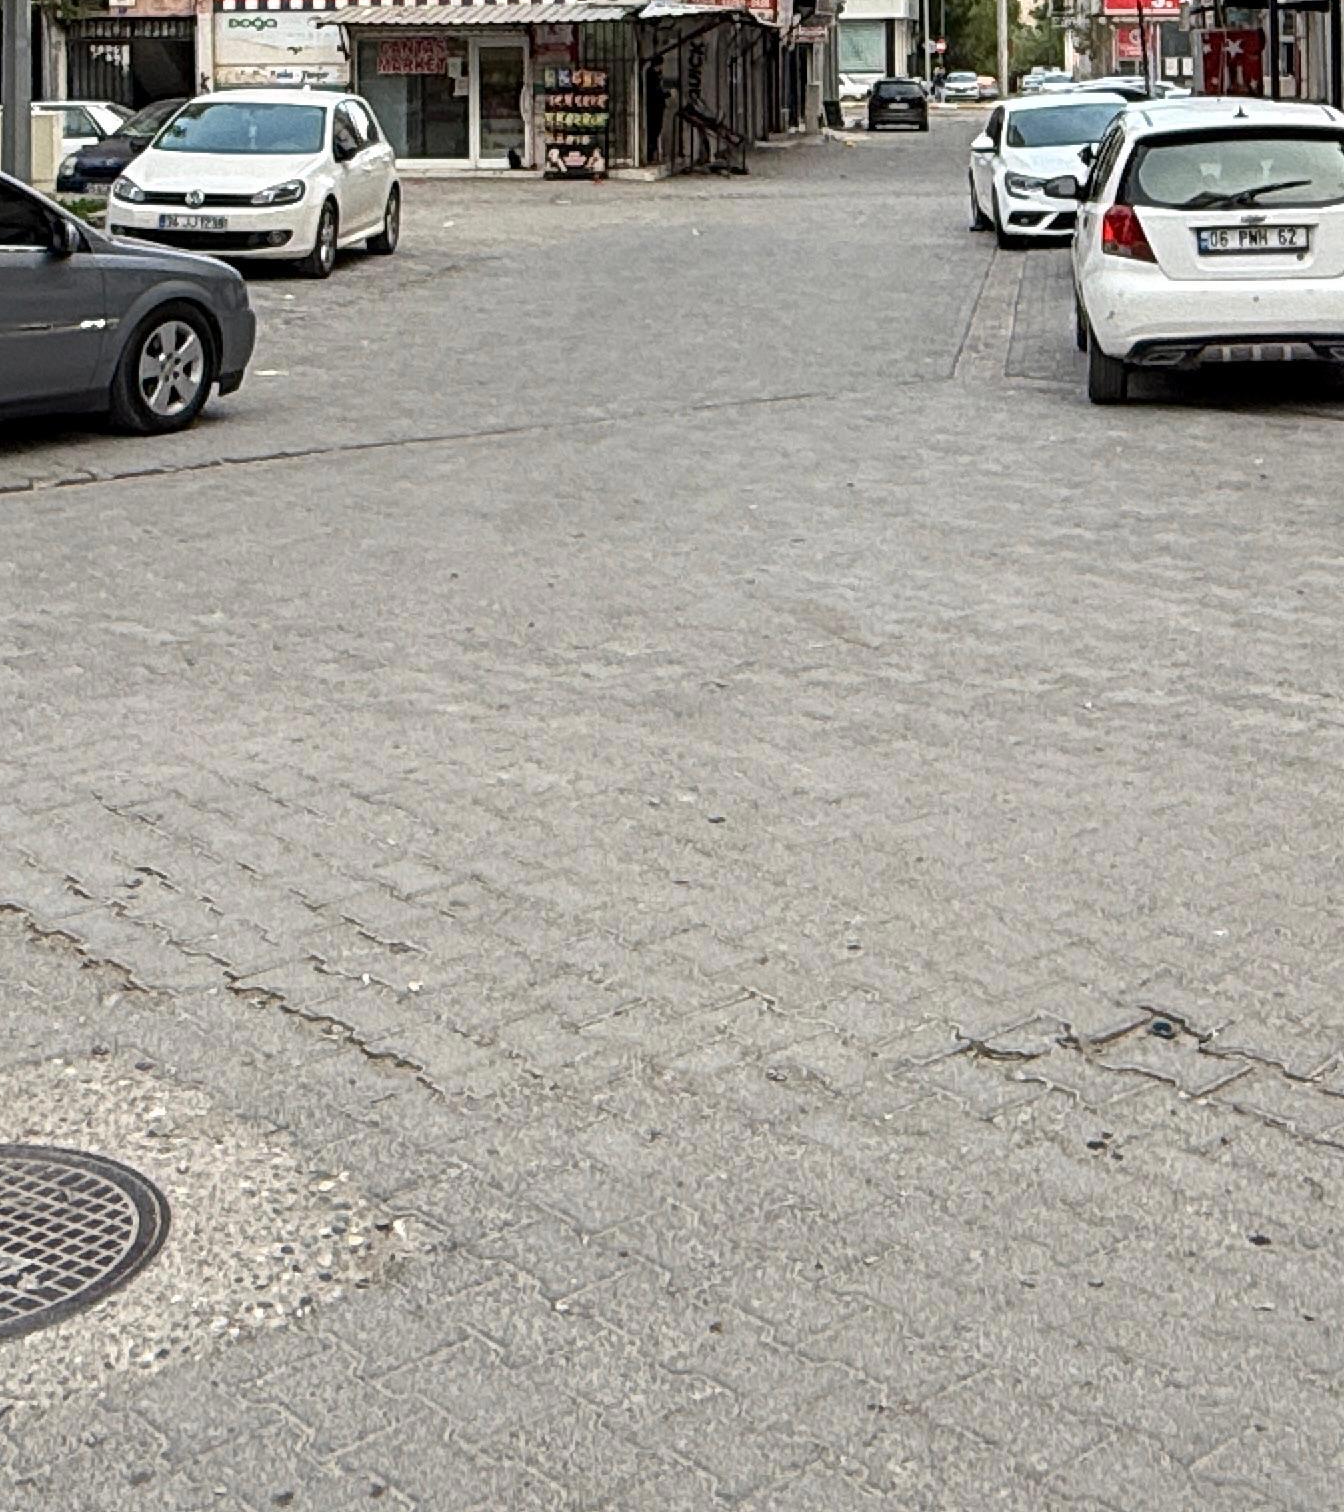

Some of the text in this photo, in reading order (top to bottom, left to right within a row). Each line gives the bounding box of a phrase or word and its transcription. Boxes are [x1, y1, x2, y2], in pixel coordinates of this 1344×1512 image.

[377, 56, 448, 74] MARKET
[1210, 230, 1229, 248] 06
[1278, 227, 1297, 246] 62
